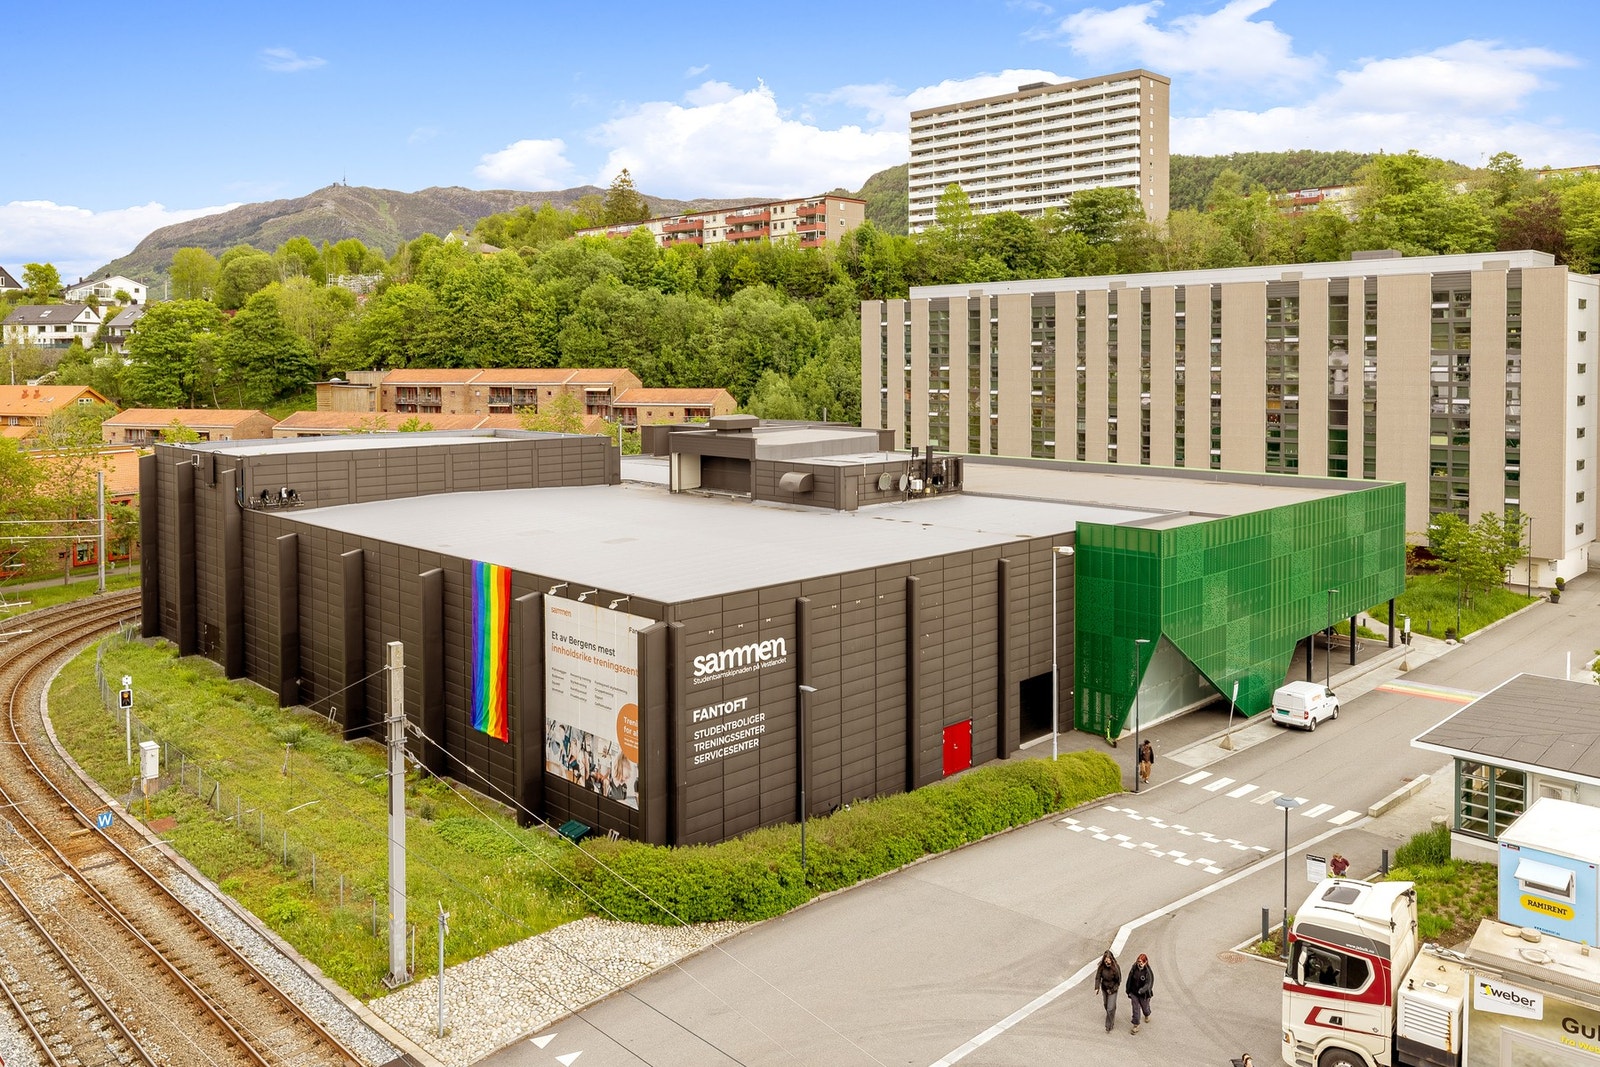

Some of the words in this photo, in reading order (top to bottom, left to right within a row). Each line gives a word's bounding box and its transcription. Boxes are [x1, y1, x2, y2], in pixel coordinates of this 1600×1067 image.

[551, 607, 572, 617] sammen
[552, 631, 558, 640] Et
[560, 634, 567, 642] av
[569, 636, 597, 651] Bergens
[598, 646, 616, 657] mest
[552, 643, 592, 663] innholdsrike
[693, 637, 787, 677] sammen
[693, 665, 752, 685] Studentsamskipnaden
[761, 657, 787, 668] Vestlandet
[693, 697, 748, 723] FANTOFT
[624, 725, 632, 734] for
[694, 713, 766, 740] STUDENTBOLIGER
[694, 725, 766, 752] TRENINGSSENTER
[694, 738, 759, 765] SERVICESENTER
[98, 813, 112, 827] W
[1527, 899, 1568, 916] RAMIRENT
[1490, 987, 1536, 1007] weber
[1561, 1036, 1576, 1047] fra
